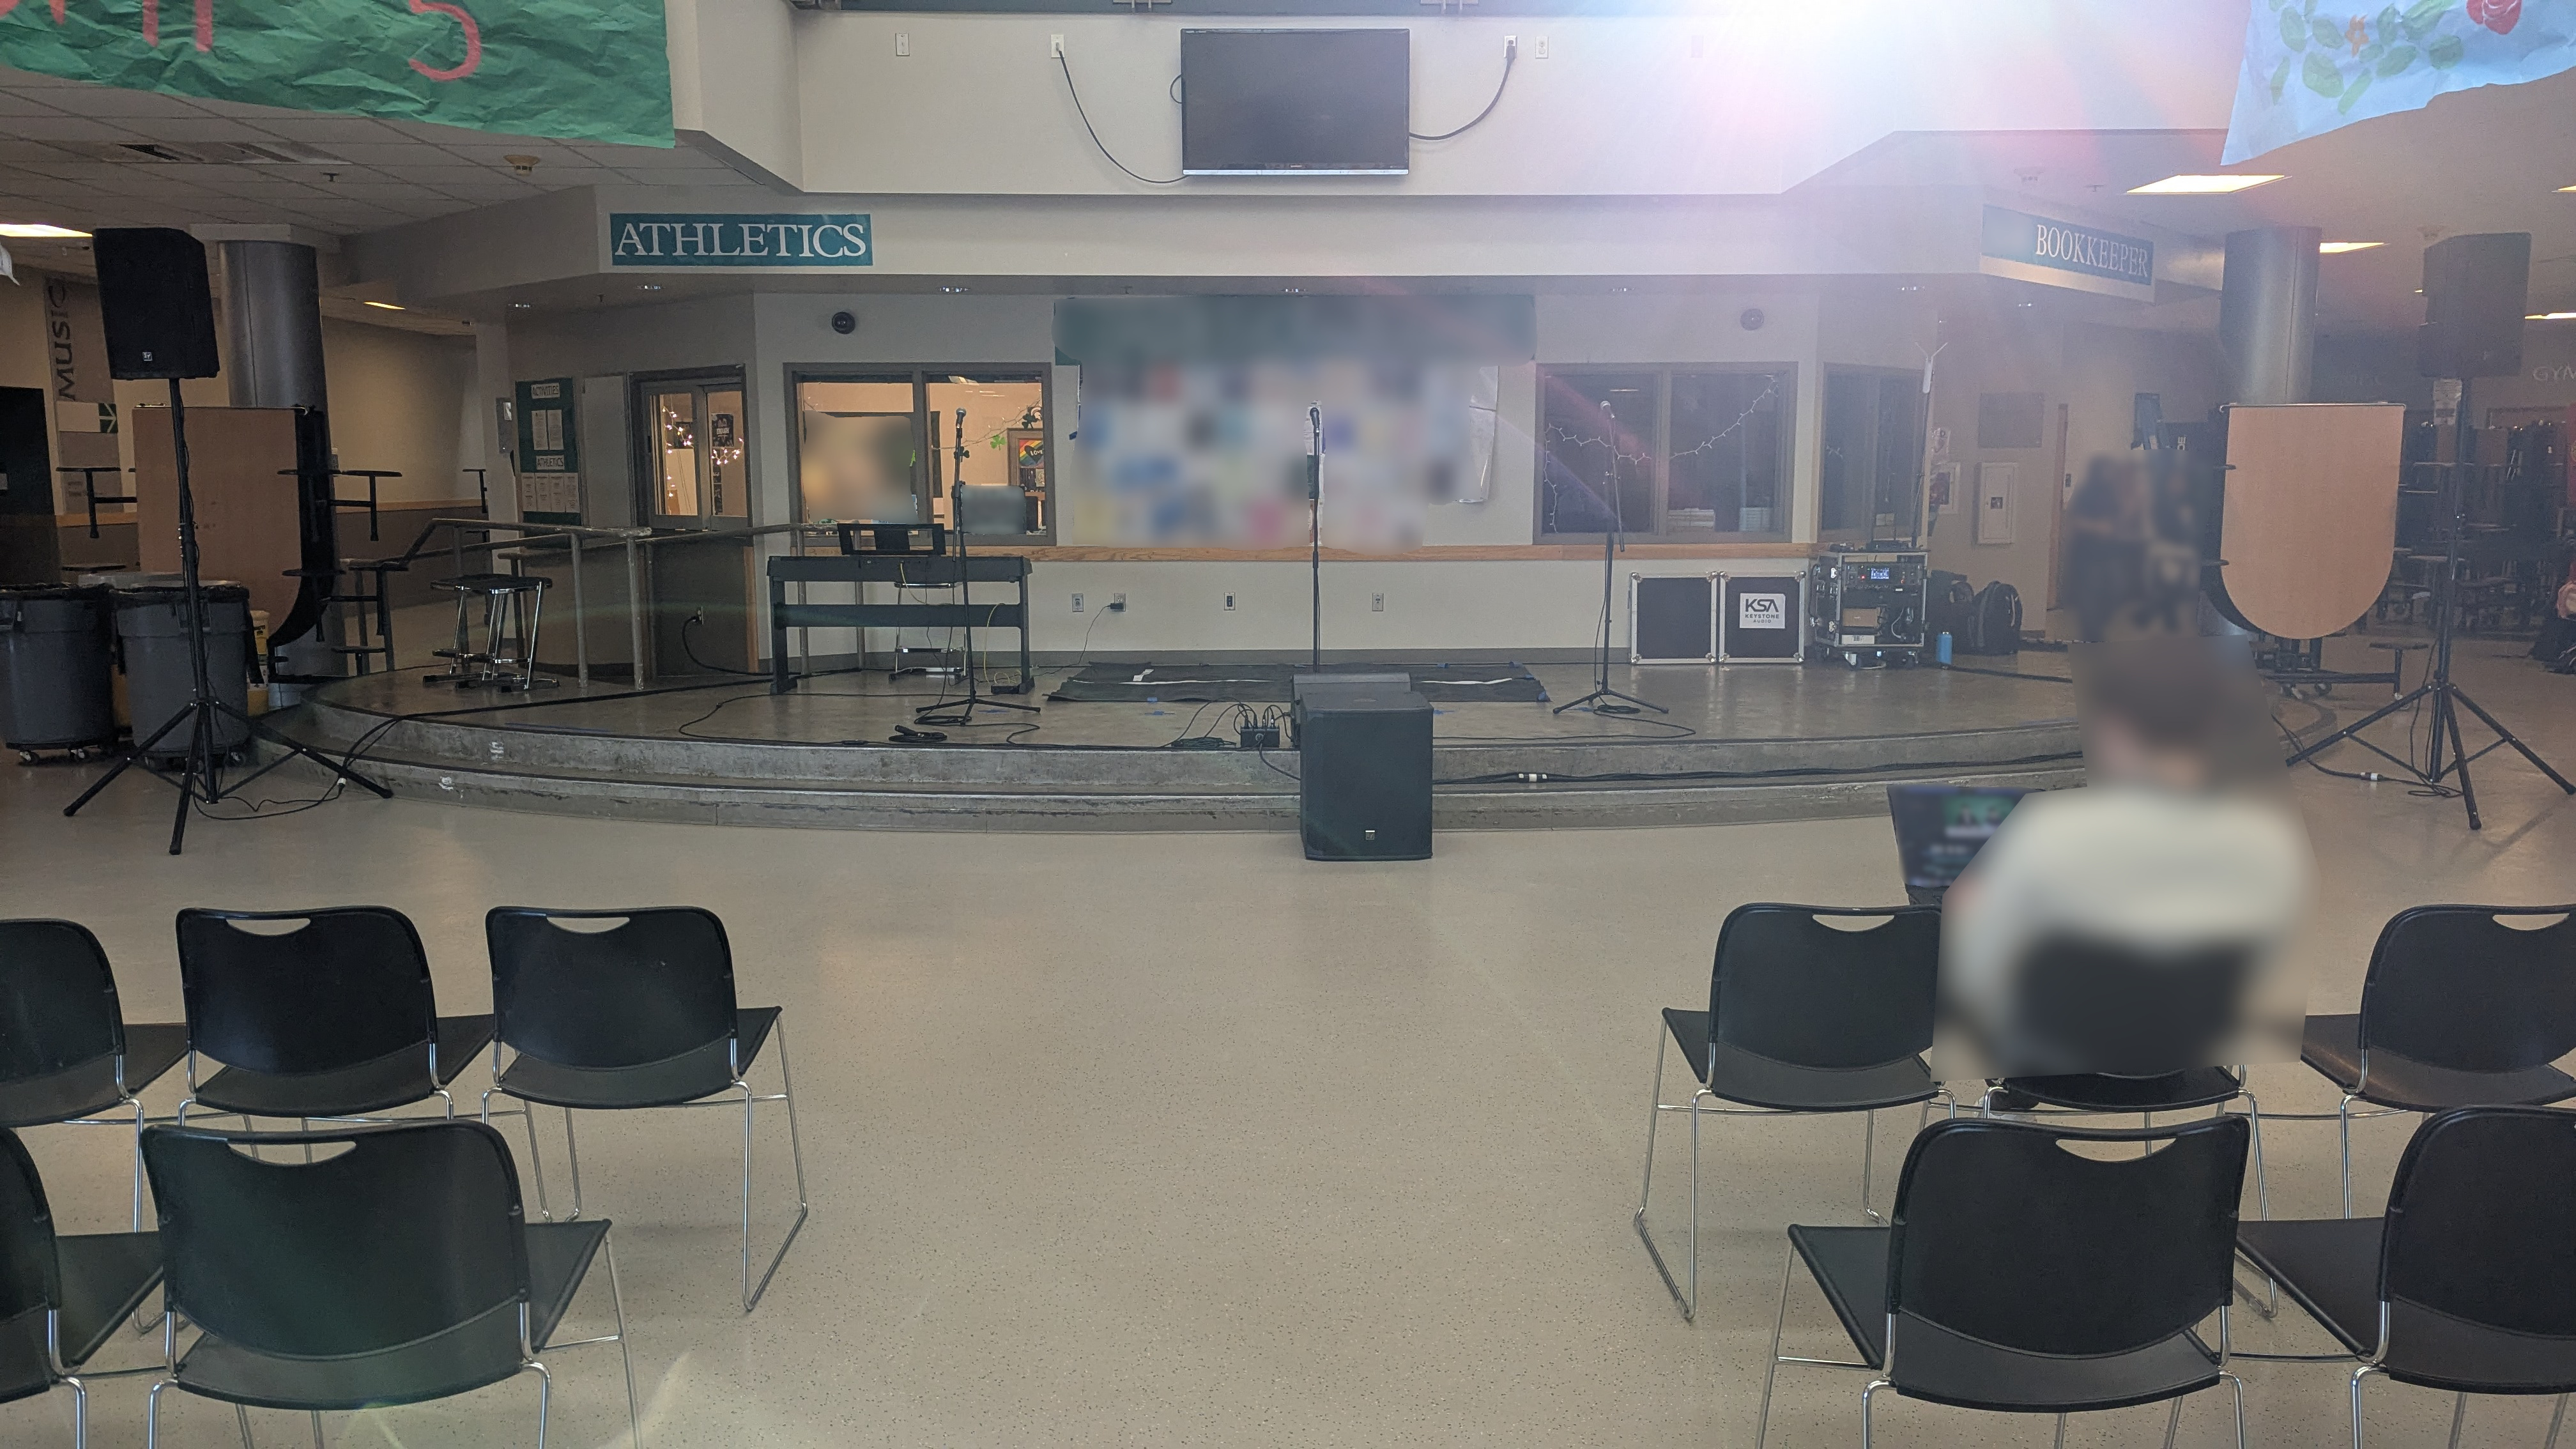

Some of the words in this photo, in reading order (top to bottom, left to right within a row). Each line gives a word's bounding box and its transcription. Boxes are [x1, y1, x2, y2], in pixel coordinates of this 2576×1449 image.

[614, 222, 867, 257] ATHLETICS
[2035, 224, 2148, 278] BOOKKEEPER
[48, 285, 76, 401] MUSIC
[532, 385, 559, 396] ACTIVITIES
[537, 457, 564, 468] ATHLETICS
[1745, 598, 1779, 613] KSA
